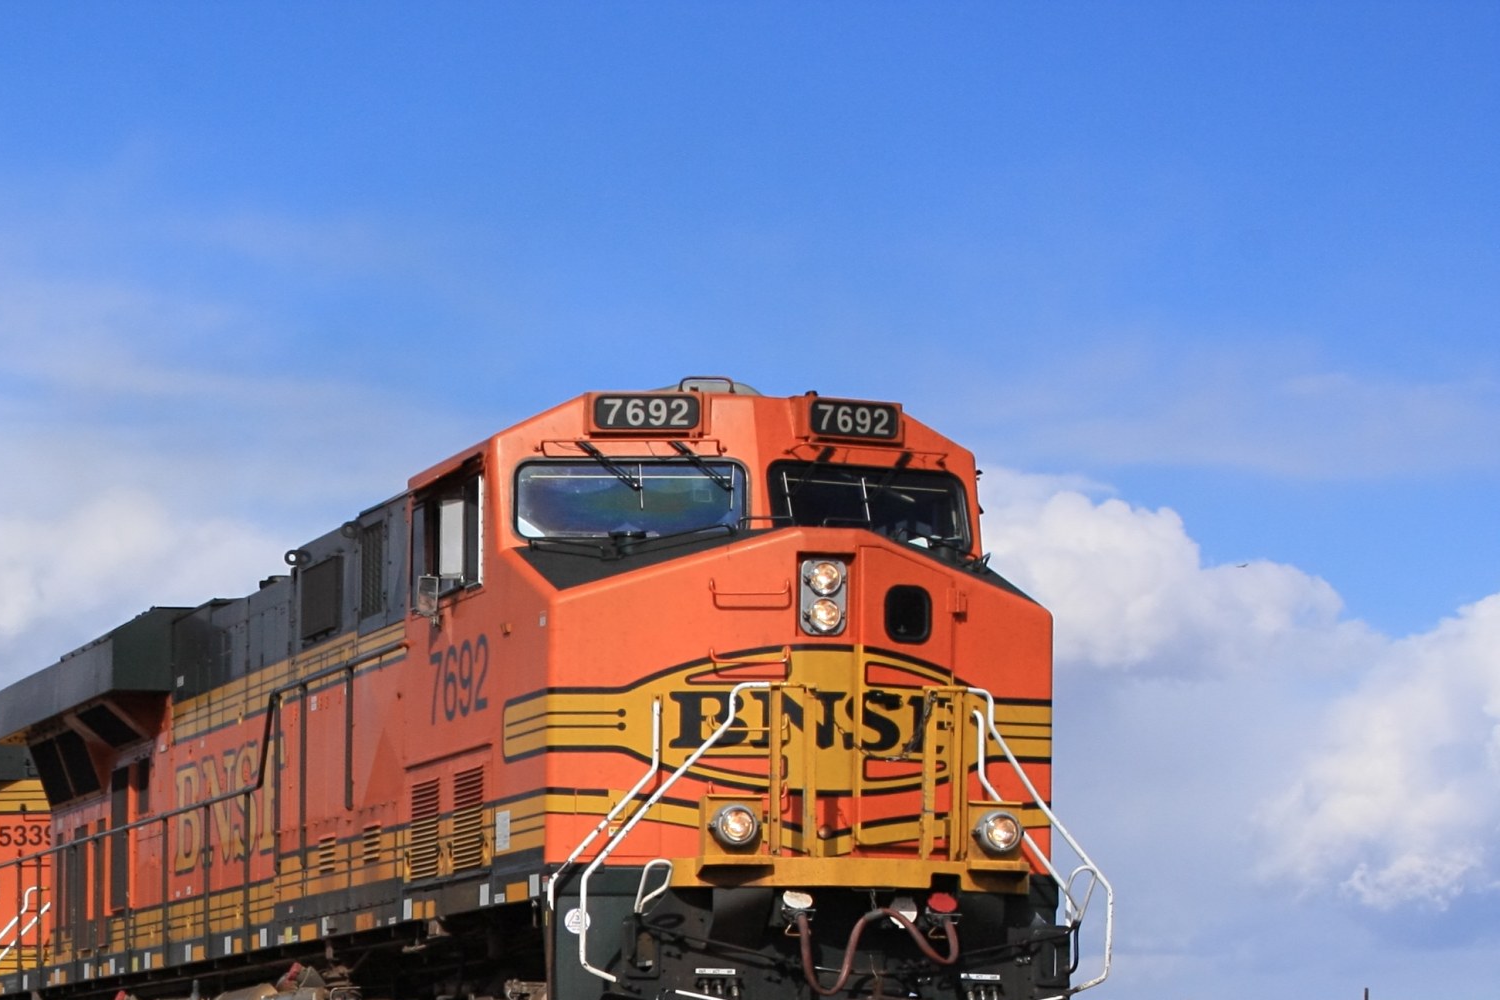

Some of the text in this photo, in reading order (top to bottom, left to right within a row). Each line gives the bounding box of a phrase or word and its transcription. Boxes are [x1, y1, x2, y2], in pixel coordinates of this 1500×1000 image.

[603, 398, 689, 426] 7692
[817, 404, 889, 435] 7692
[430, 633, 488, 726] 7692
[669, 691, 953, 751] BNSF
[175, 731, 284, 876] BNSF
